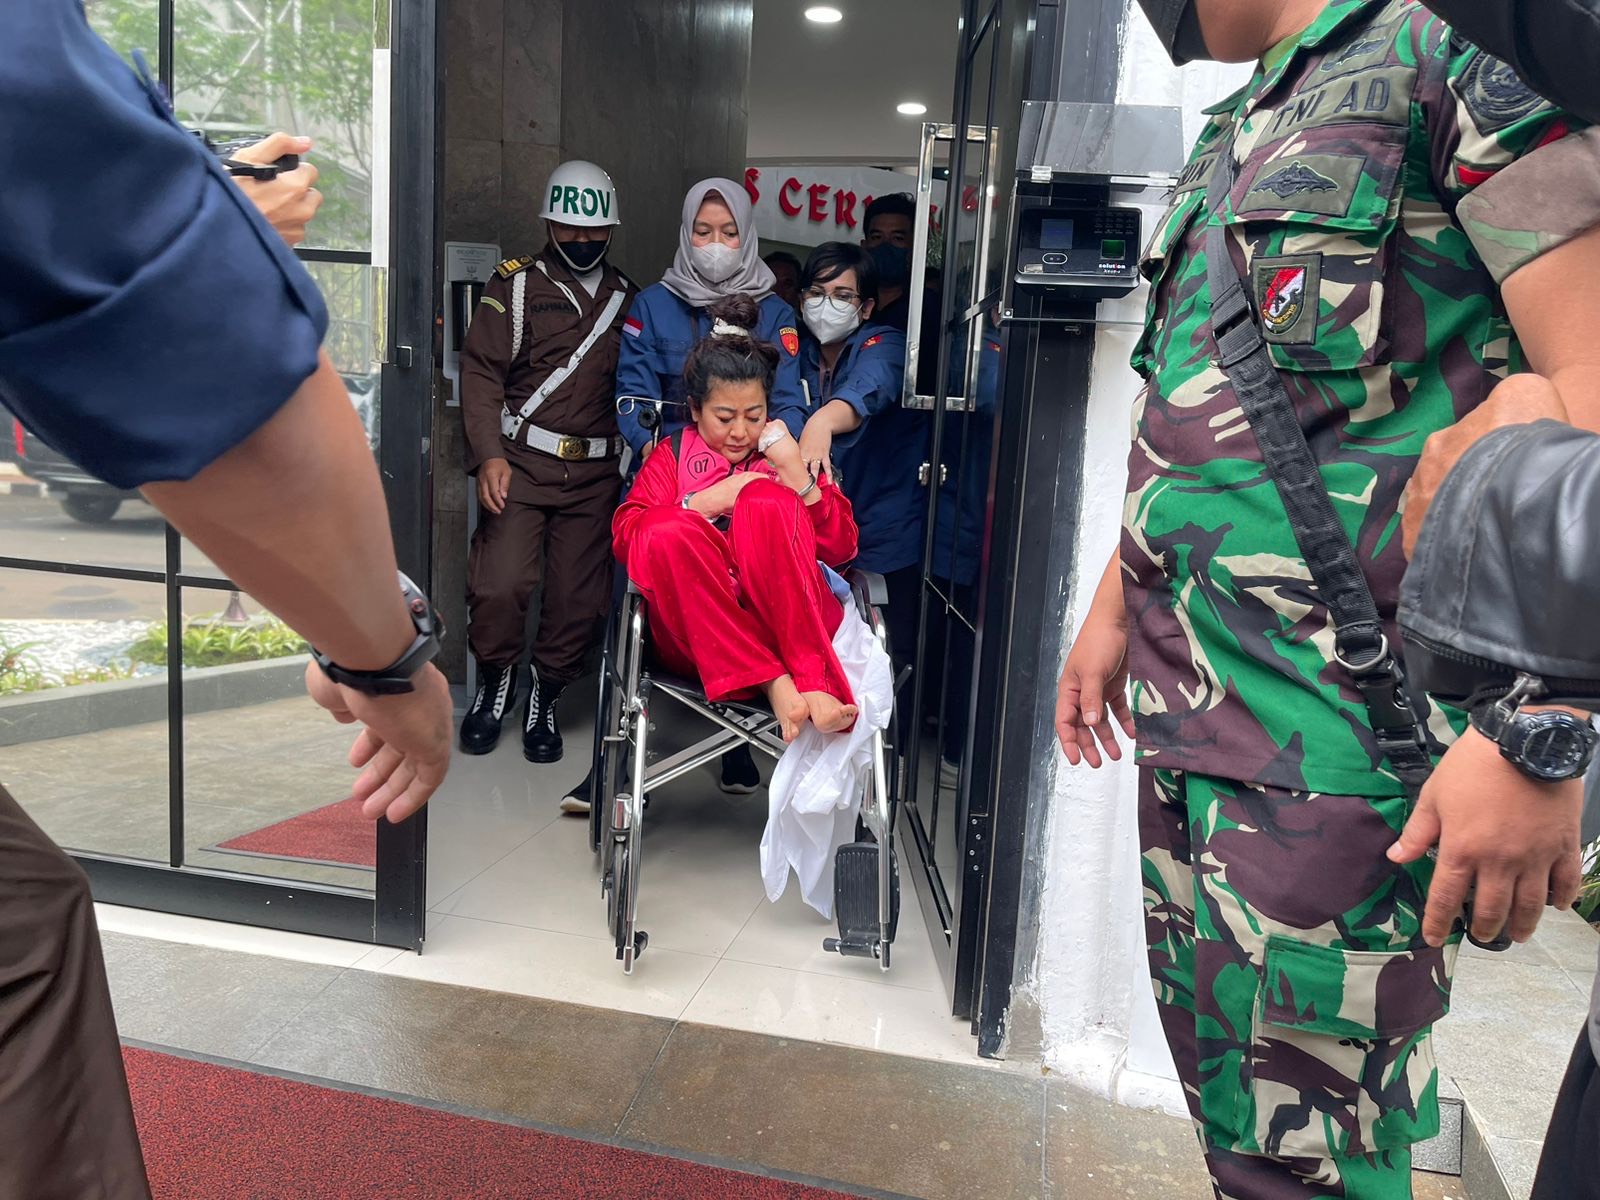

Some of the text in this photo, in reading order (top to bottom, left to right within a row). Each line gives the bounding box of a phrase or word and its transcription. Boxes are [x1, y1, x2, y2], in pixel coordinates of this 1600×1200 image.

[1272, 76, 1391, 134] TNI AD
[549, 185, 611, 218] PROV
[694, 458, 709, 474] 07
